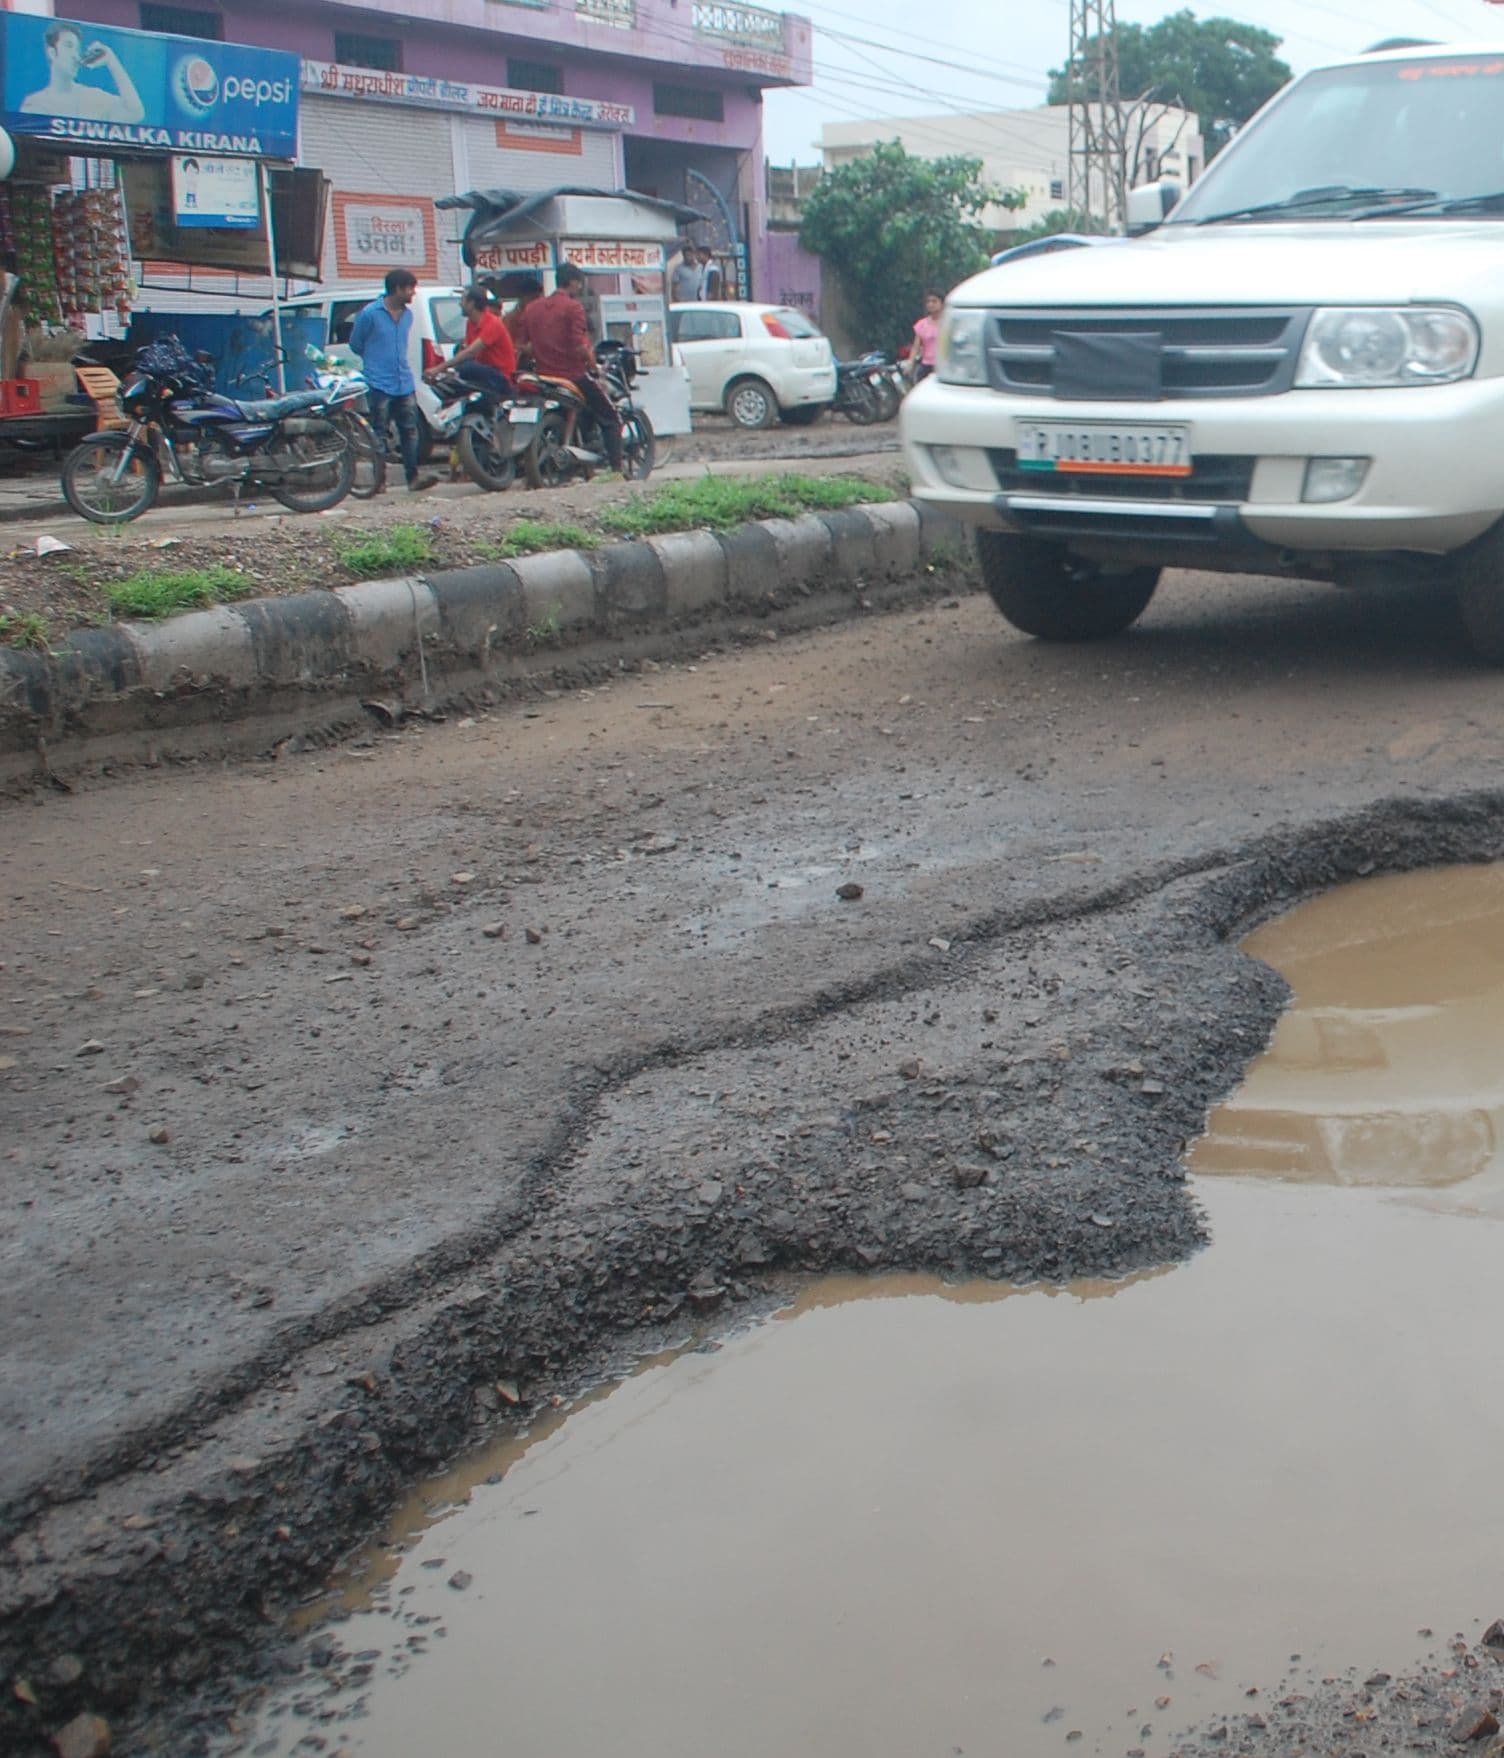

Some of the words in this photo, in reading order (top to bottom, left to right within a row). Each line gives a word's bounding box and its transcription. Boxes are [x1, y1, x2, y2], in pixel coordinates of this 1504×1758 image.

[223, 77, 291, 107] pepsi
[50, 118, 173, 147] SUWALKA
[177, 130, 263, 154] KIRANA
